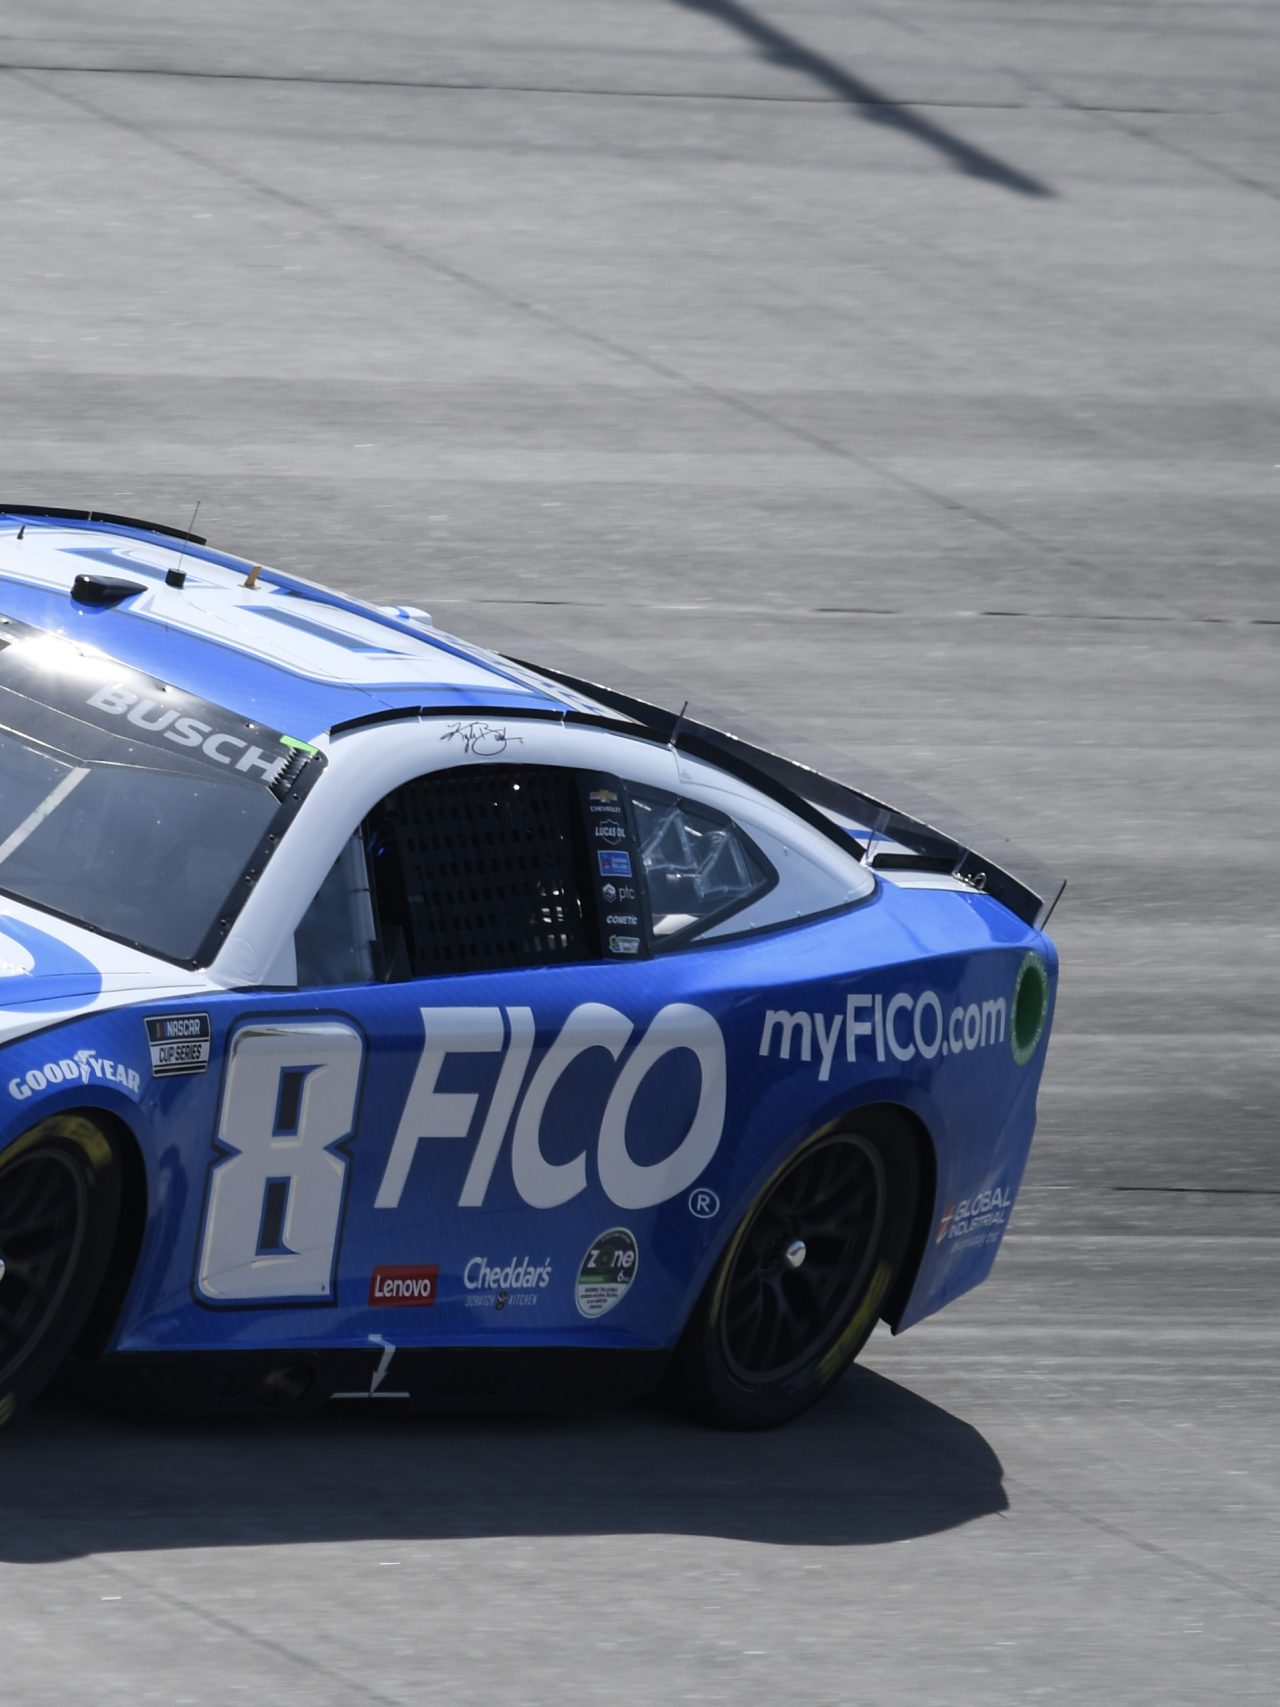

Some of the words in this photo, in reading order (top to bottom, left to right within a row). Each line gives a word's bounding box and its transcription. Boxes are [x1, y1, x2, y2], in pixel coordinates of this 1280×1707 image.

[86, 680, 284, 785] BUSCH
[167, 1018, 201, 1036] NASCAR
[759, 990, 1007, 1081] myFICO.com
[159, 1046, 175, 1063] CUP
[176, 1044, 202, 1062] SERIES
[8, 1052, 141, 1100] GOODYEAR
[374, 1002, 727, 1209] FICO
[197, 1018, 365, 1303] 8
[954, 1187, 1011, 1222] GLOBAL
[374, 1274, 431, 1297] Lenovo
[463, 1256, 552, 1289] Cheddar's
